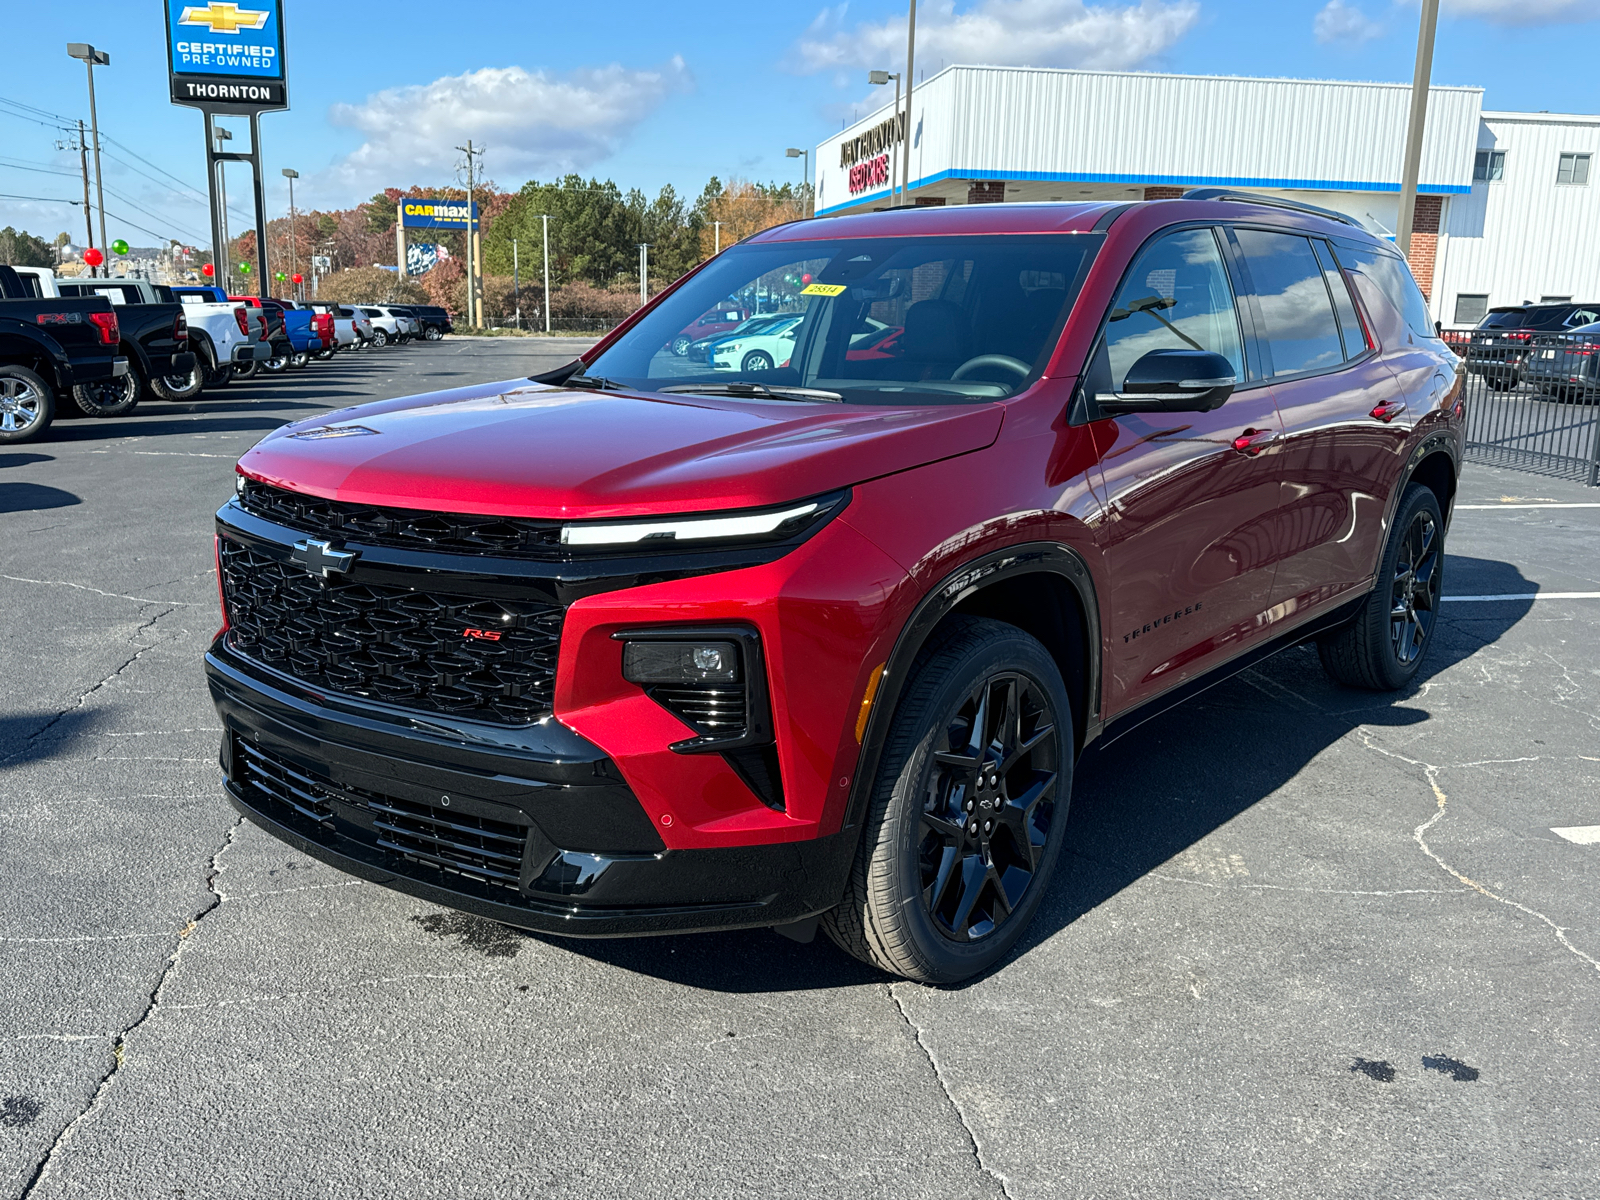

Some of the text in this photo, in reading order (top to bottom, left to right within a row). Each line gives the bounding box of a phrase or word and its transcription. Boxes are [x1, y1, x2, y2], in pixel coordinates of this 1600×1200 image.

[176, 41, 275, 57] CERTIFIED
[182, 53, 271, 68] PRE-OWNED
[186, 83, 271, 100] THORNTON
[848, 153, 887, 194] USED CARS
[36, 312, 82, 325] FX4
[1123, 602, 1203, 643] TRAVERSE
[463, 628, 502, 641] RS
